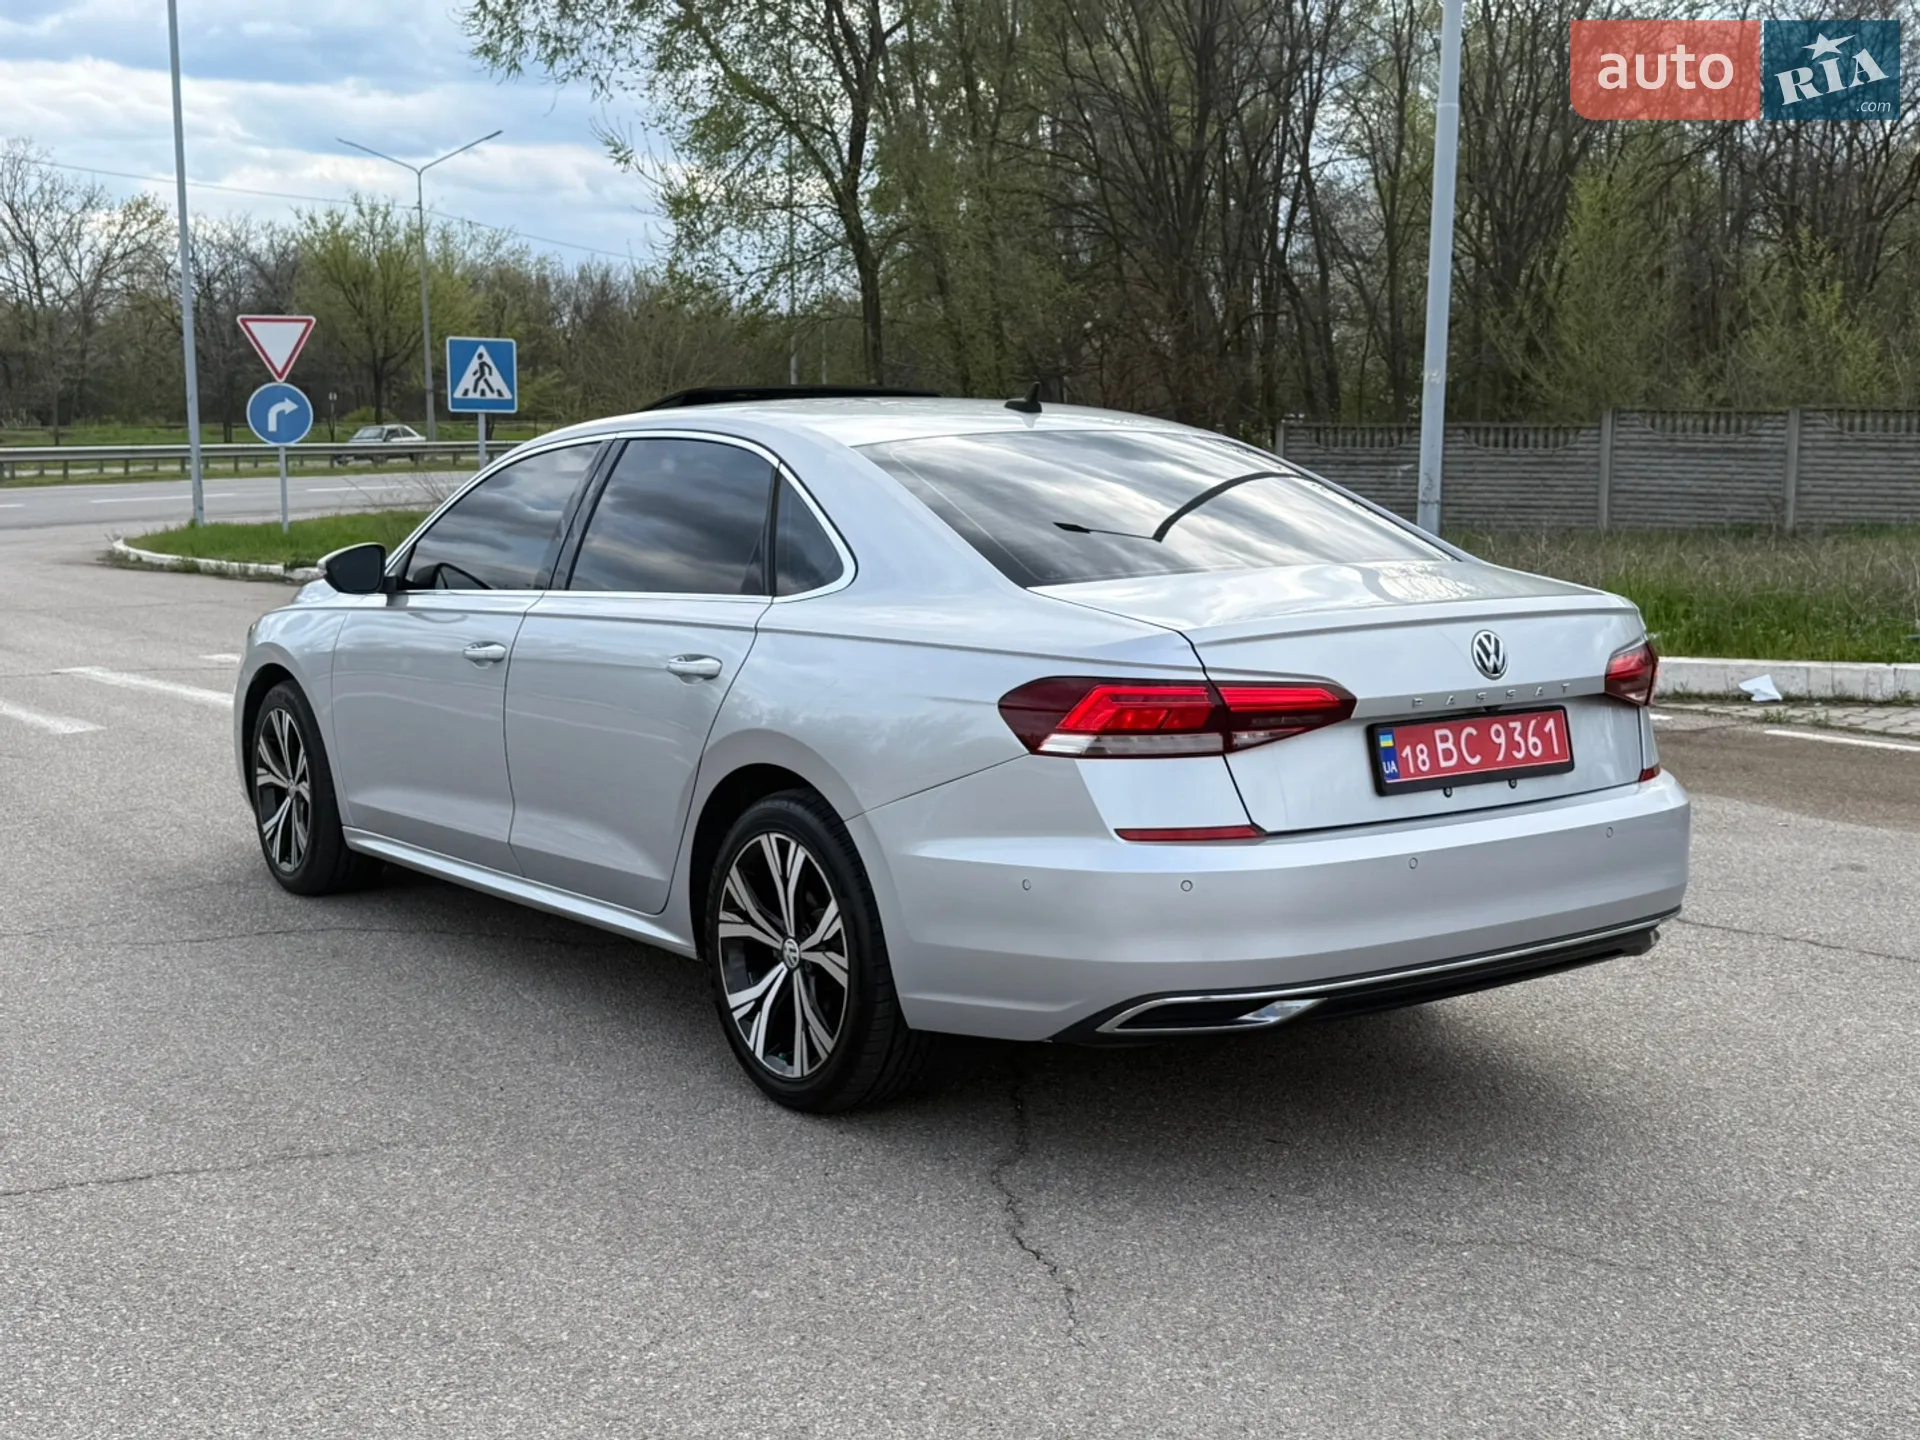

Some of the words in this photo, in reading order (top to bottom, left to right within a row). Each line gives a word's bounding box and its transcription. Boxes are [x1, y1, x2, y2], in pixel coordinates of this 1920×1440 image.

[1412, 682, 1570, 708] PASSAT
[1401, 743, 1430, 773] 18
[1434, 726, 1482, 768] BC
[1490, 717, 1559, 762] 9361
[1383, 761, 1398, 774] UA
